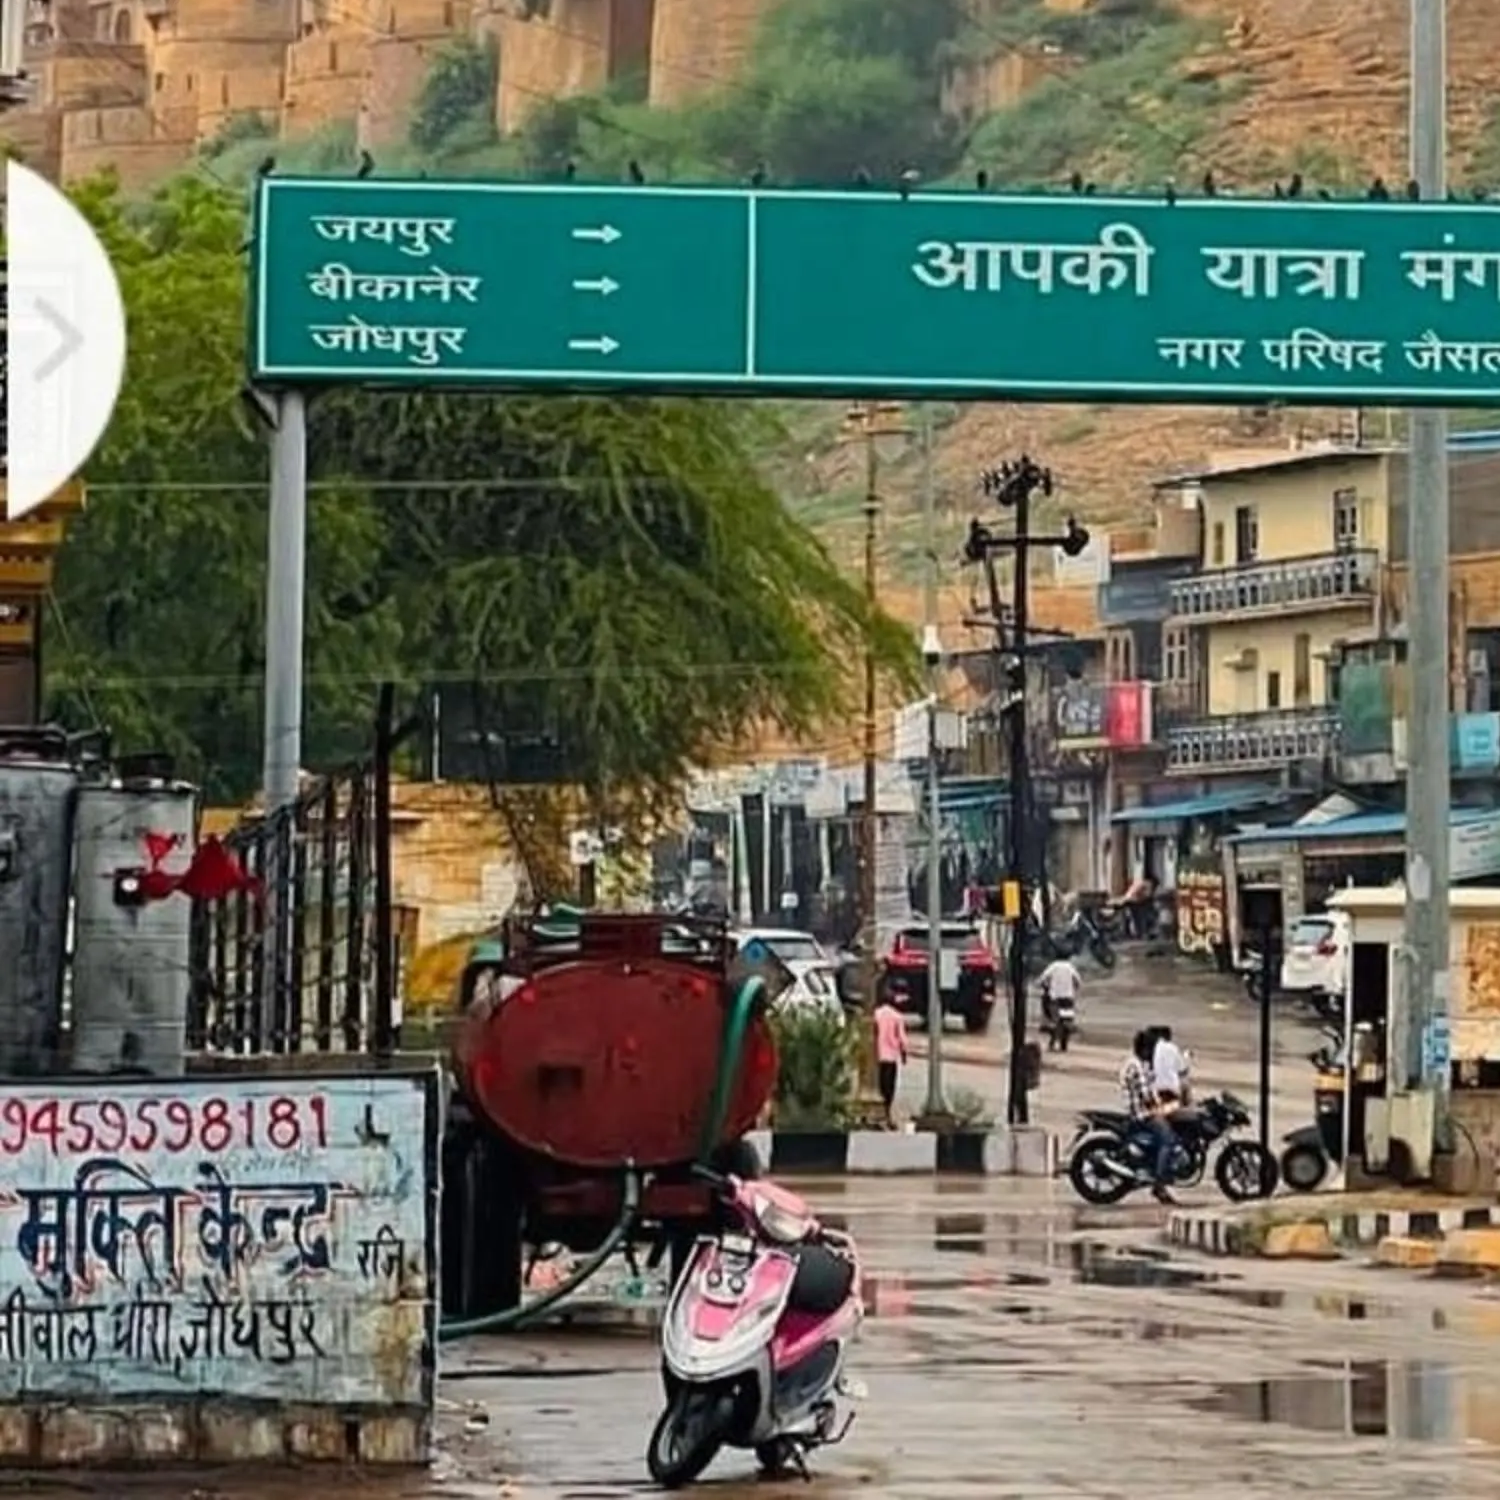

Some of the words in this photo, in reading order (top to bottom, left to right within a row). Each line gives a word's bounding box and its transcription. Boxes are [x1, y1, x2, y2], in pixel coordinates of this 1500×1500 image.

[310, 216, 456, 255] जयपुर
[308, 263, 481, 302] बीकानेर
[911, 223, 1154, 295] आपकी
[1201, 247, 1365, 299] यात्रा
[309, 315, 466, 364] जोधपुर
[1157, 337, 1244, 369] नगर
[1261, 328, 1385, 372] परिषद
[0, 1096, 327, 1157] 9459598181
